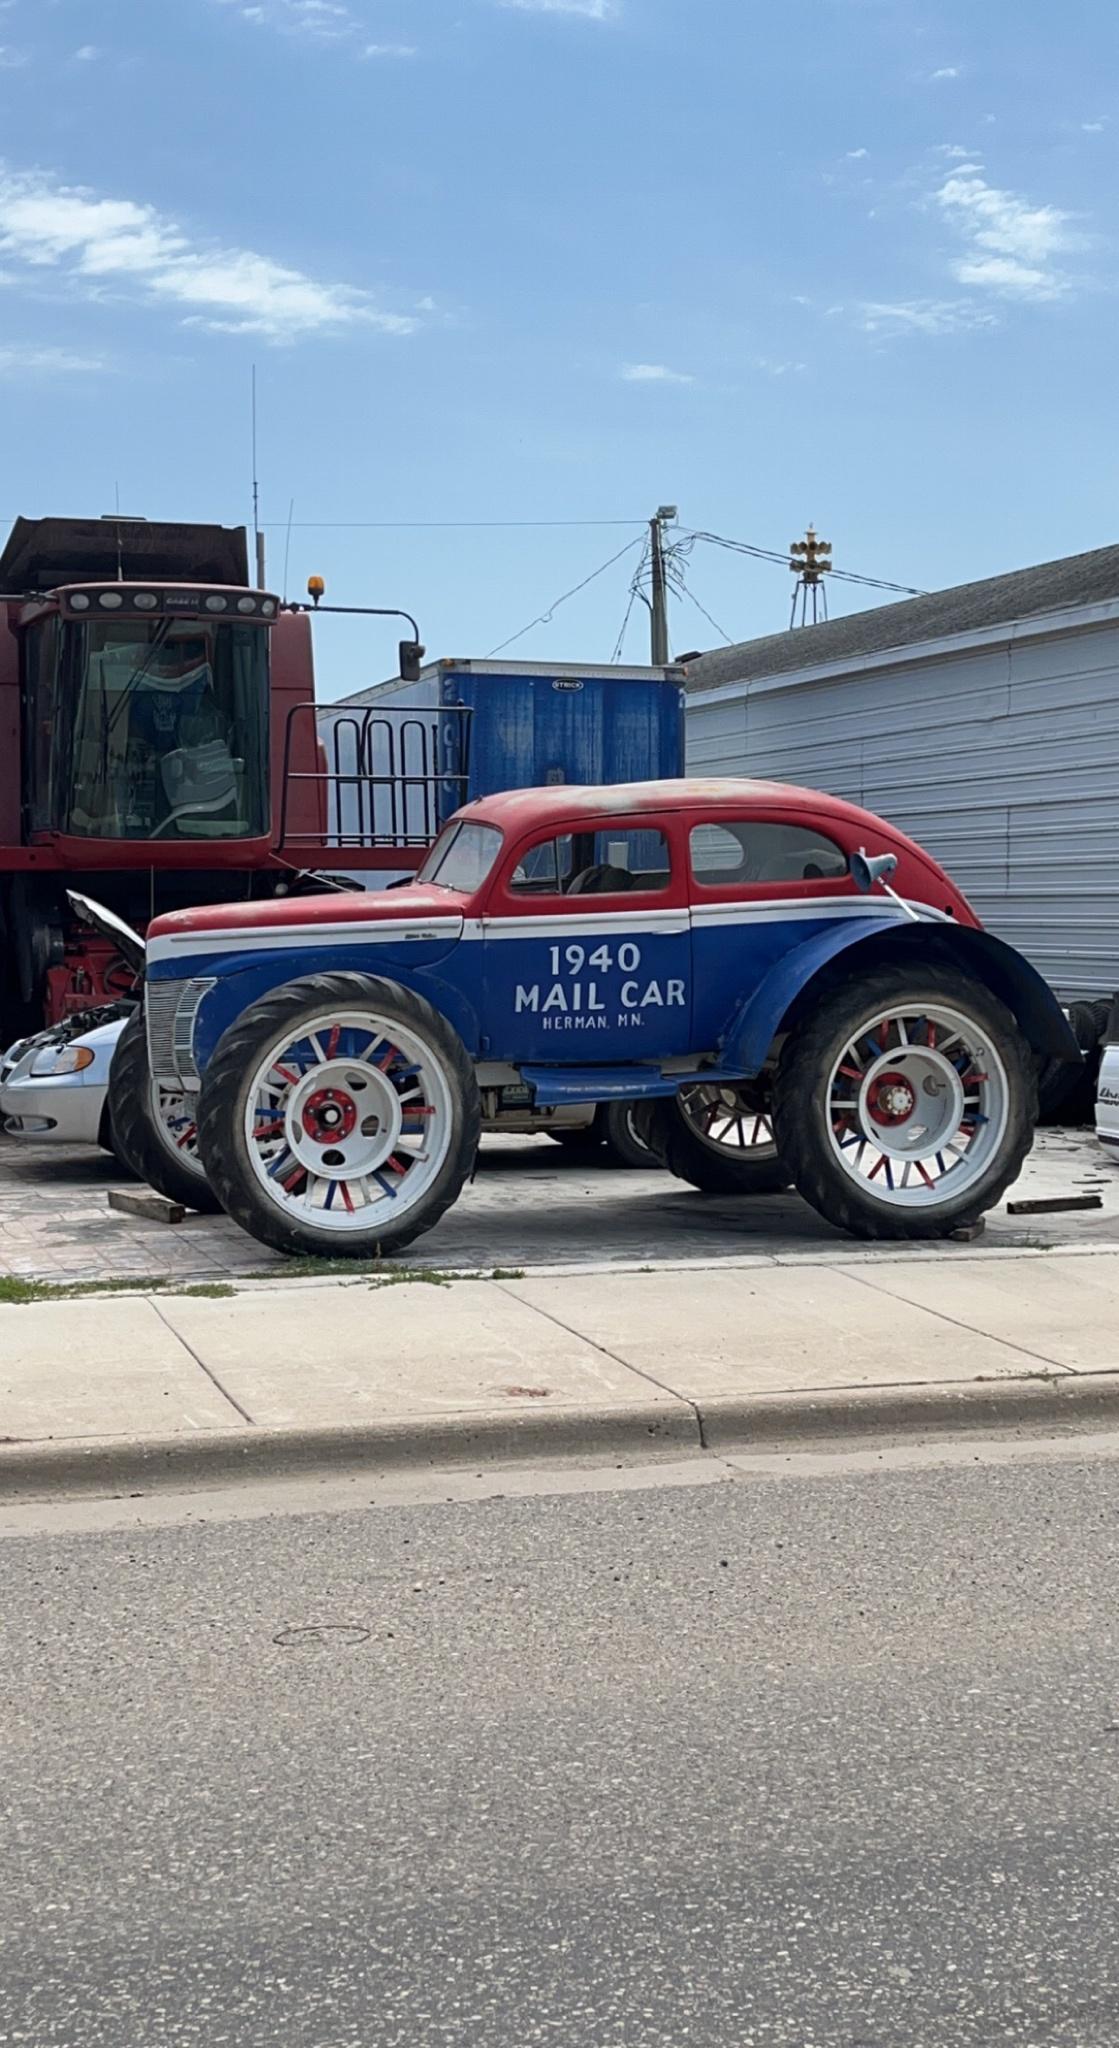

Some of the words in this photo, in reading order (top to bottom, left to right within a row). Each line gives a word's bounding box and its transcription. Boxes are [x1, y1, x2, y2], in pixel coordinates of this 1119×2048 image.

[549, 942, 641, 975] 1940
[514, 982, 606, 1013] MAIL
[620, 979, 686, 1008] CAR
